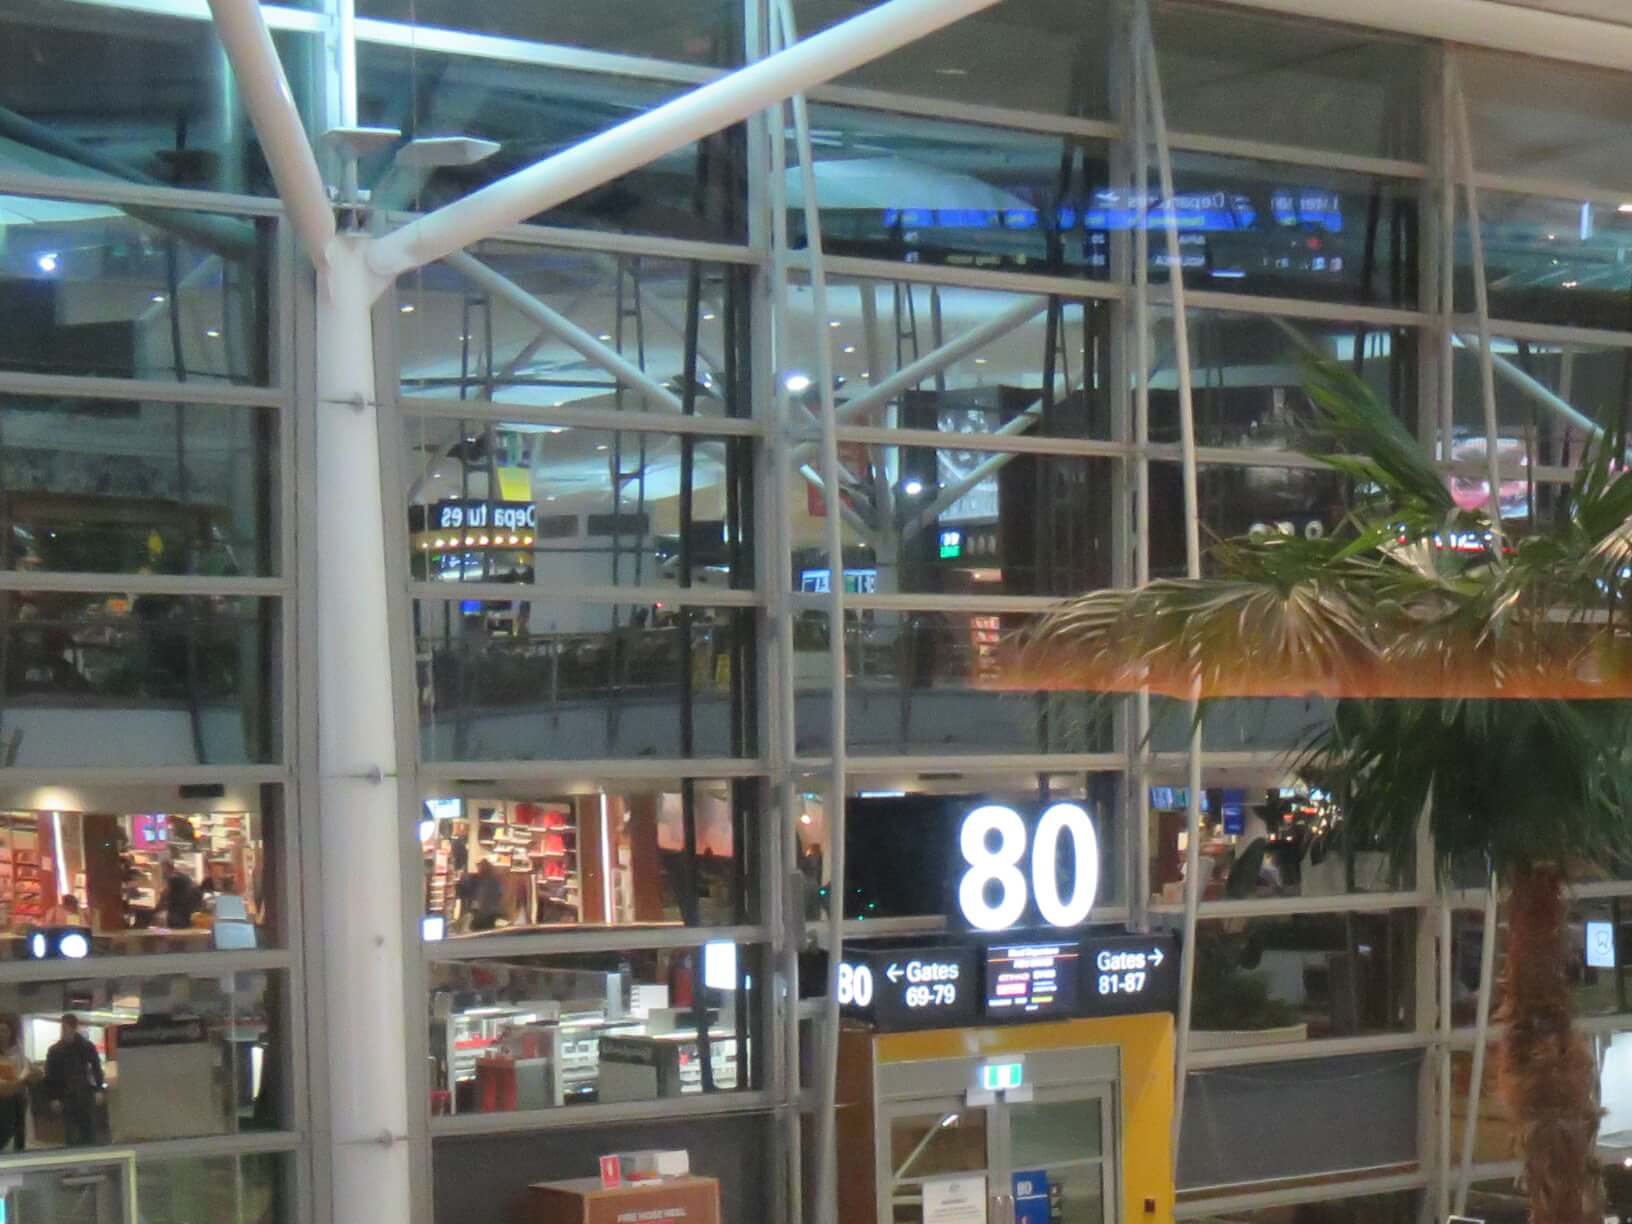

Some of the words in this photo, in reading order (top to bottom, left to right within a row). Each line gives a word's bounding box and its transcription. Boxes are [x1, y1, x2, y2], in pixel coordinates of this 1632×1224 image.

[959, 803, 1098, 931] 80
[907, 961, 959, 983] Gates
[1097, 950, 1146, 971] Gates
[838, 963, 873, 1007] 80
[1099, 971, 1146, 994] 81-87
[906, 983, 956, 1007] 69-79
